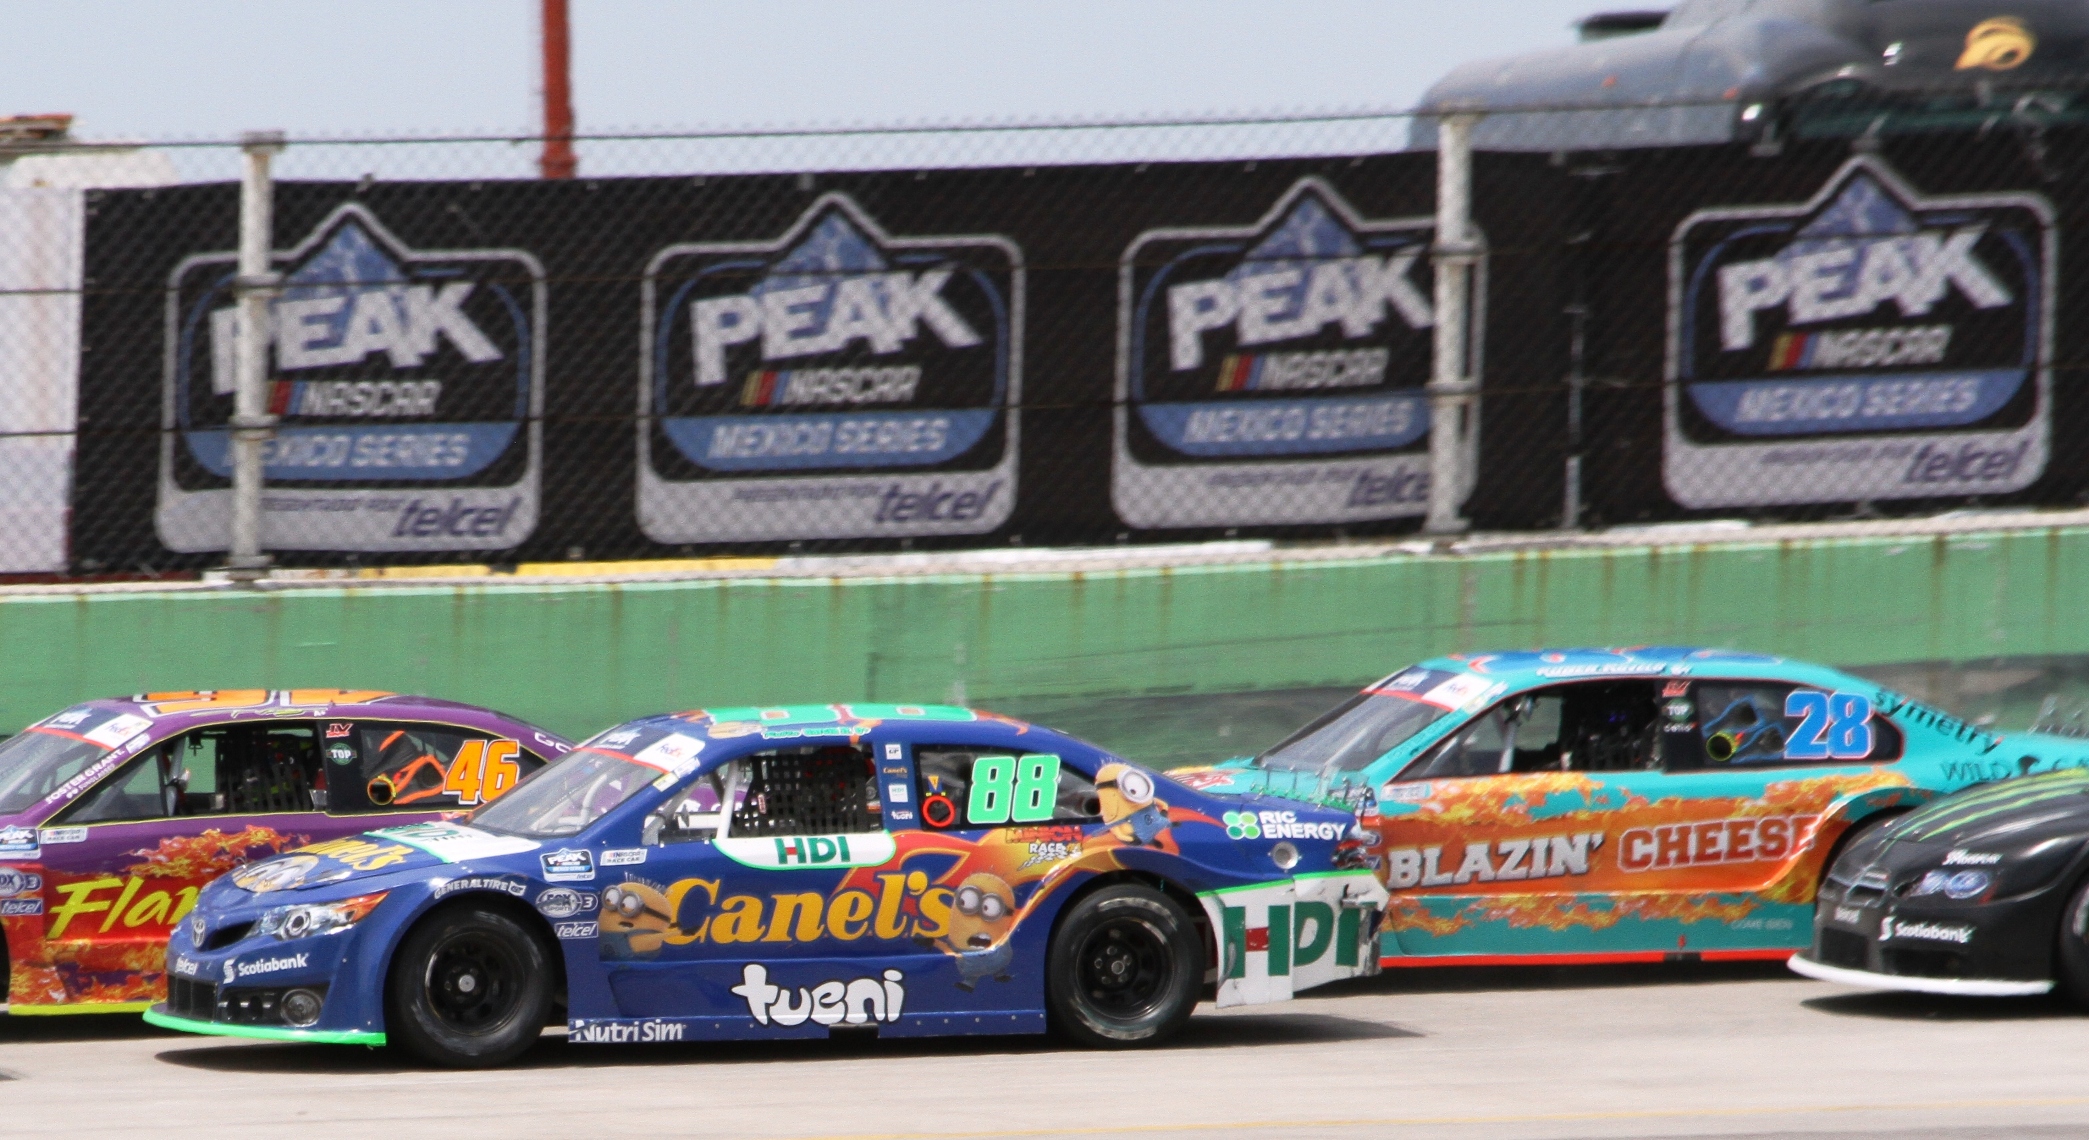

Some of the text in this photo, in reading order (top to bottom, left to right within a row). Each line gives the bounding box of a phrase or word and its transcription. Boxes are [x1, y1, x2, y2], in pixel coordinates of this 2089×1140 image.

[1717, 223, 2014, 352] PEAK
[689, 262, 985, 387] PEAK
[1166, 245, 1436, 372] PEAK
[1808, 324, 1953, 368] NASCAR
[782, 366, 922, 405] NASCAR
[1258, 348, 1390, 389] NASCAR
[302, 380, 442, 418] NASCAR
[1733, 376, 1985, 423] MEXICO SERIES
[706, 419, 951, 459] MEXICO SERIES
[1180, 402, 1416, 444] MEXICO SERIES
[351, 433, 473, 467] SERIES
[1902, 437, 2035, 483] telcel
[391, 498, 523, 540] telcel
[873, 482, 1002, 525] telcel
[1784, 689, 1874, 760] 28
[331, 749, 351, 760] TOP
[443, 739, 520, 804] 46
[1940, 760, 2013, 781] WILD
[45, 773, 87, 804] FOSTER
[967, 755, 1060, 824] 88
[1259, 811, 1296, 824] RIC
[1262, 823, 1347, 841] ENERGY
[774, 836, 850, 864] HDI
[1388, 833, 1605, 889] BLAZIN'
[1618, 814, 1821, 874] CHEESE
[434, 878, 482, 900] GENERAL
[483, 879, 509, 891] TIRE
[583, 897, 593, 908] 3
[662, 871, 955, 945] Canel's
[556, 922, 595, 938] telcel
[1223, 901, 1361, 979] HDI
[1895, 920, 1977, 944] Scotiabank
[237, 953, 308, 975] Scotiabank
[731, 963, 905, 1026] tueni
[575, 1018, 684, 1042] Nutri Sim
